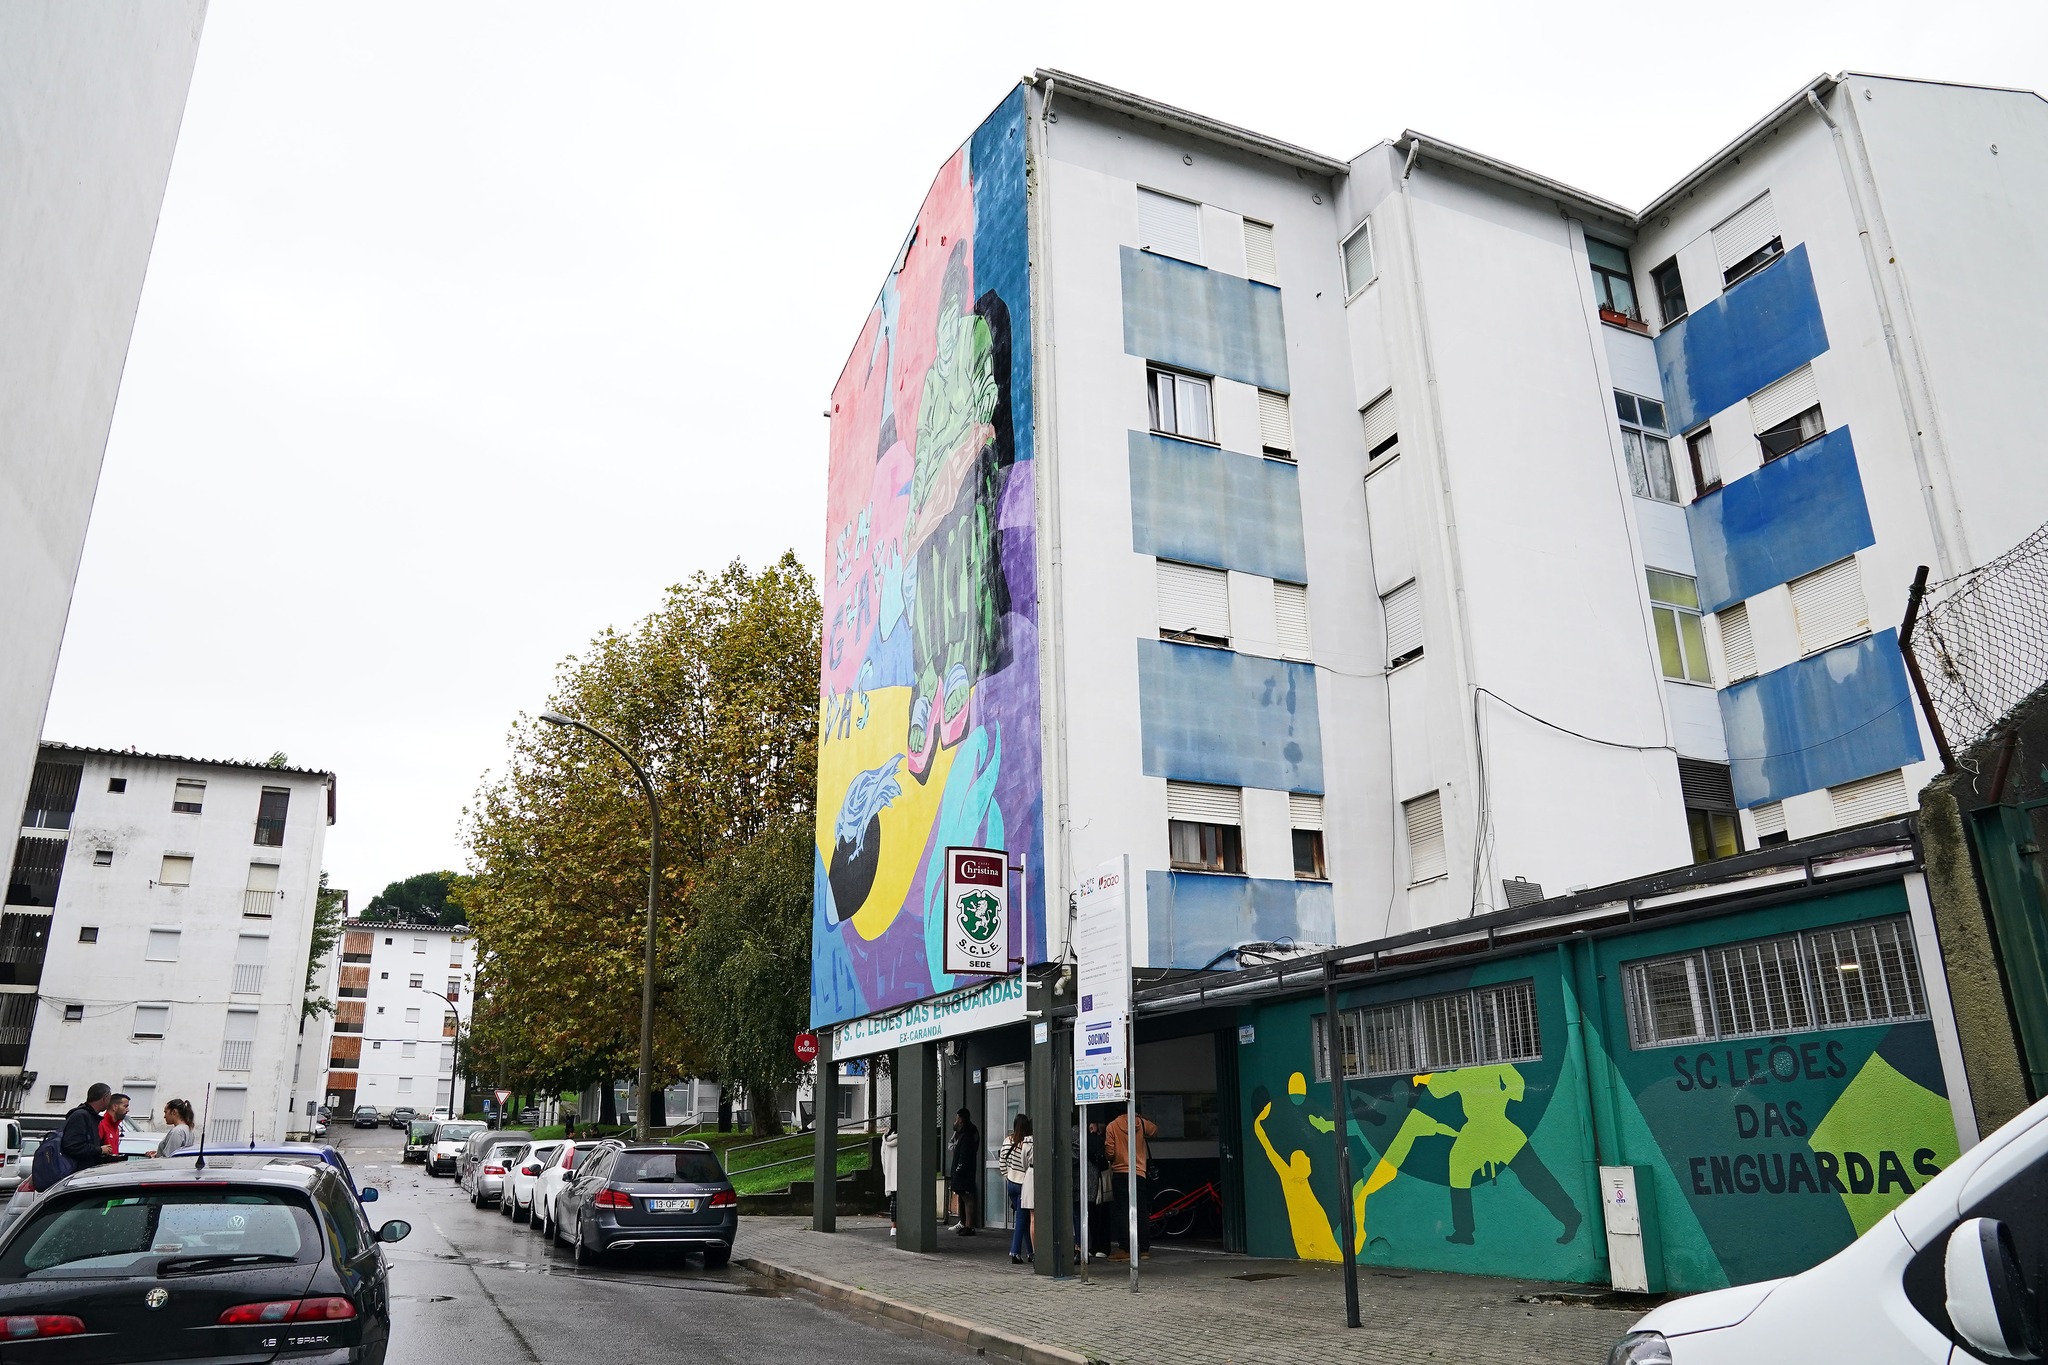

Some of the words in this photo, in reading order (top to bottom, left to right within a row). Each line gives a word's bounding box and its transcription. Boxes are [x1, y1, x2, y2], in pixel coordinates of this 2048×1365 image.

[961, 860, 999, 879] Christina
[1103, 874, 1120, 889] 2020
[969, 960, 992, 968] SEDE
[905, 1004, 930, 1027] DAS
[933, 976, 1023, 1021] ENGUARDAS
[899, 1022, 943, 1043] EX-CARANDÁ
[1726, 1036, 1848, 1089] LEÕES
[1734, 1100, 1809, 1139] DAS
[1688, 1147, 1943, 1196] ENGUARDAS
